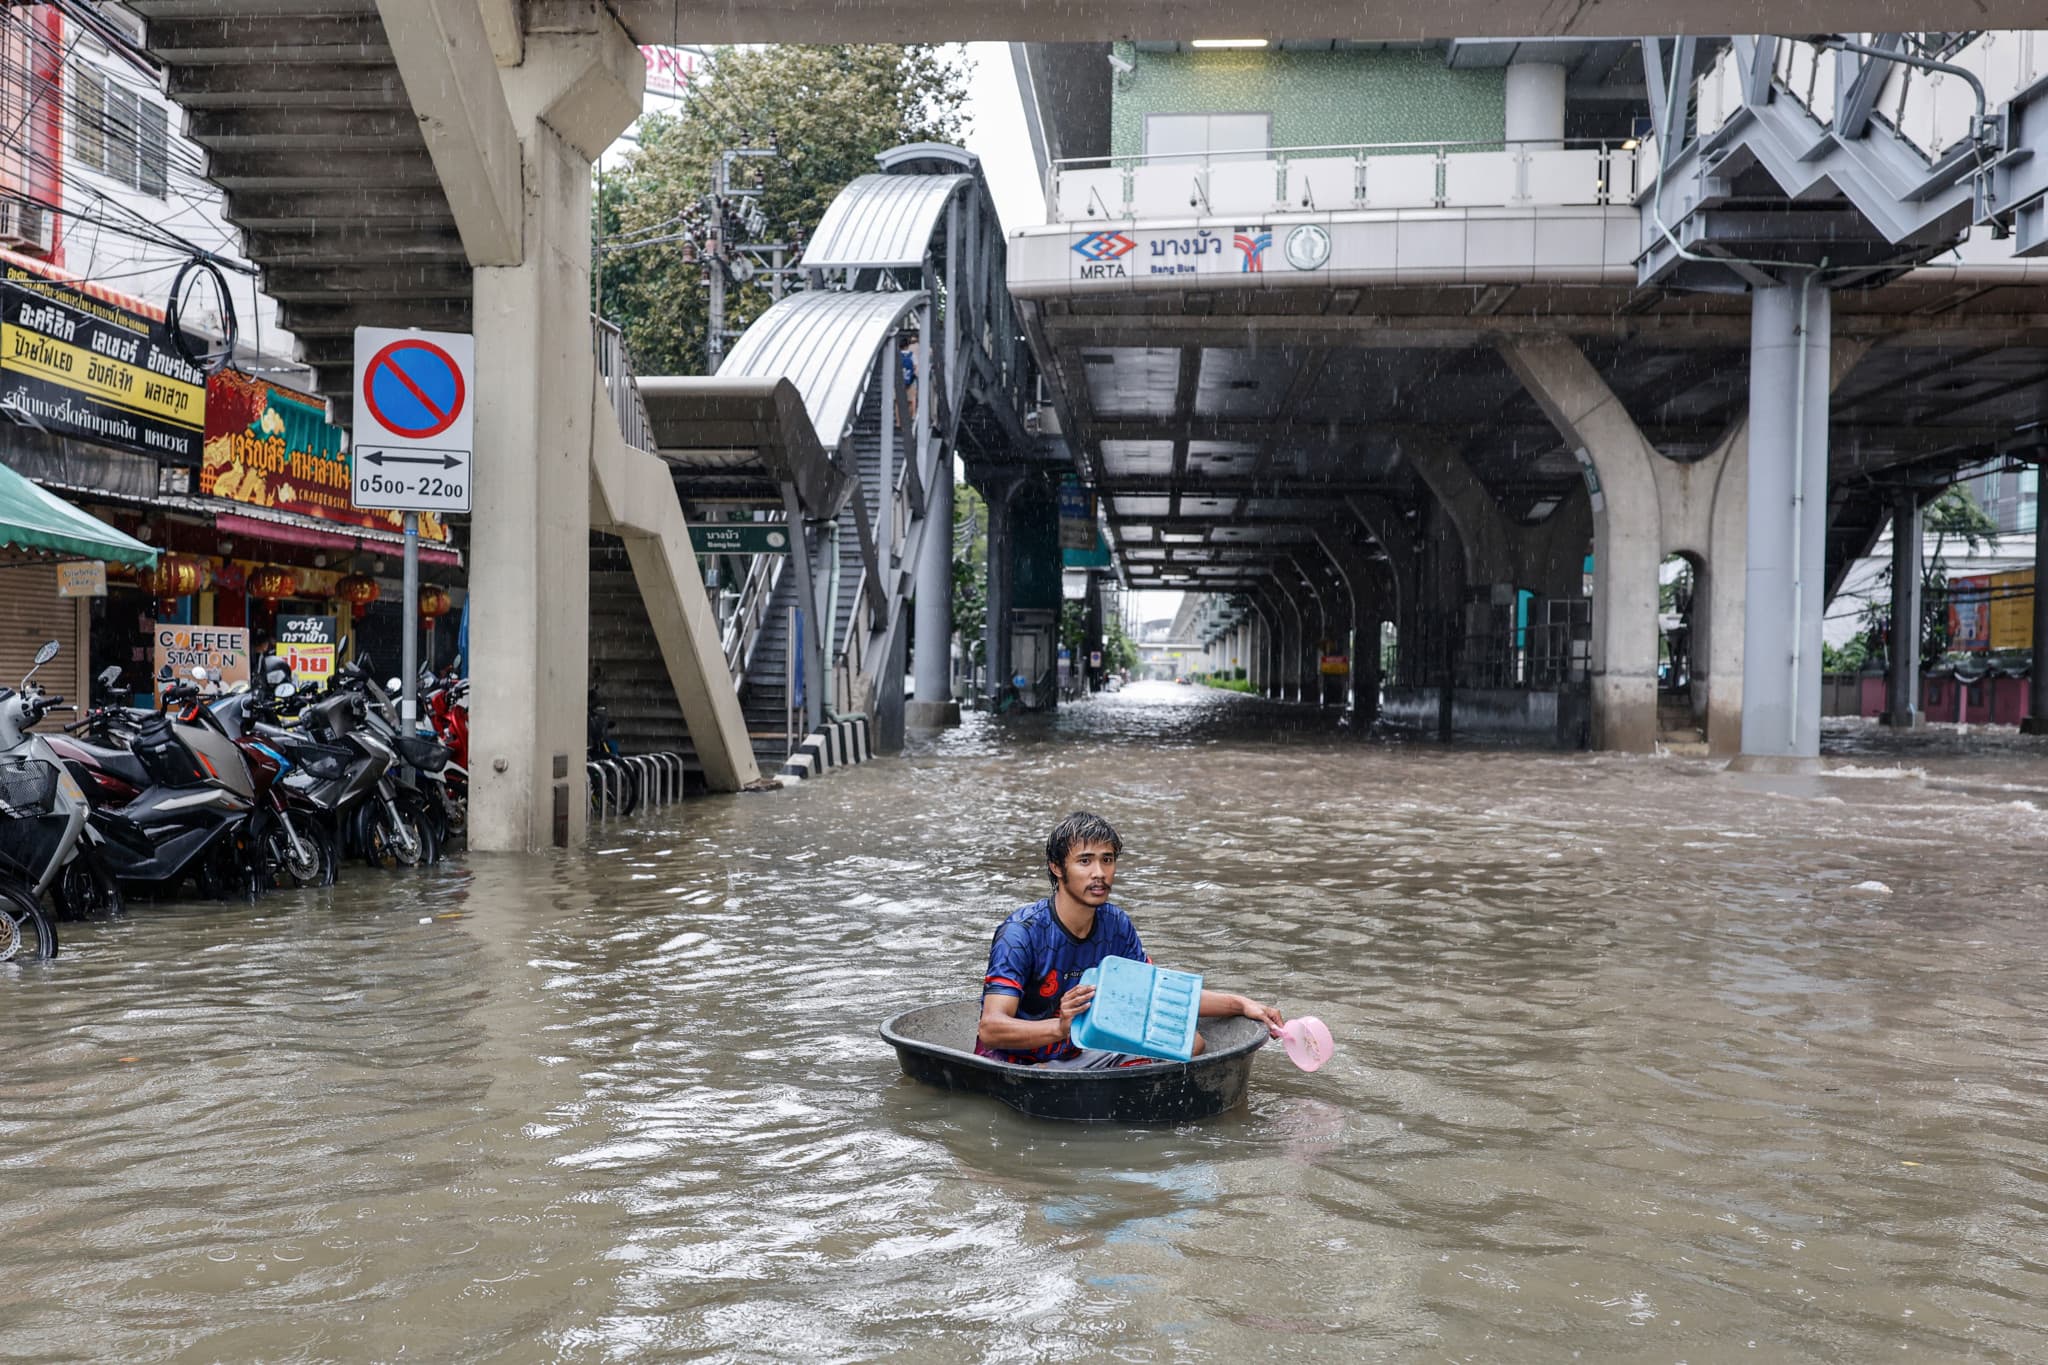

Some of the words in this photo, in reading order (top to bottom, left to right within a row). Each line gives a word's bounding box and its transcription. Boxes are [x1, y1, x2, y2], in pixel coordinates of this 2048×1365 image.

[1150, 230, 1222, 256] บางบัว
[1080, 264, 1126, 279] MRTA
[1151, 264, 1175, 275] Bang
[706, 529, 739, 539] บางบัว
[159, 630, 242, 650] COFFEE
[167, 651, 234, 666] STATION
